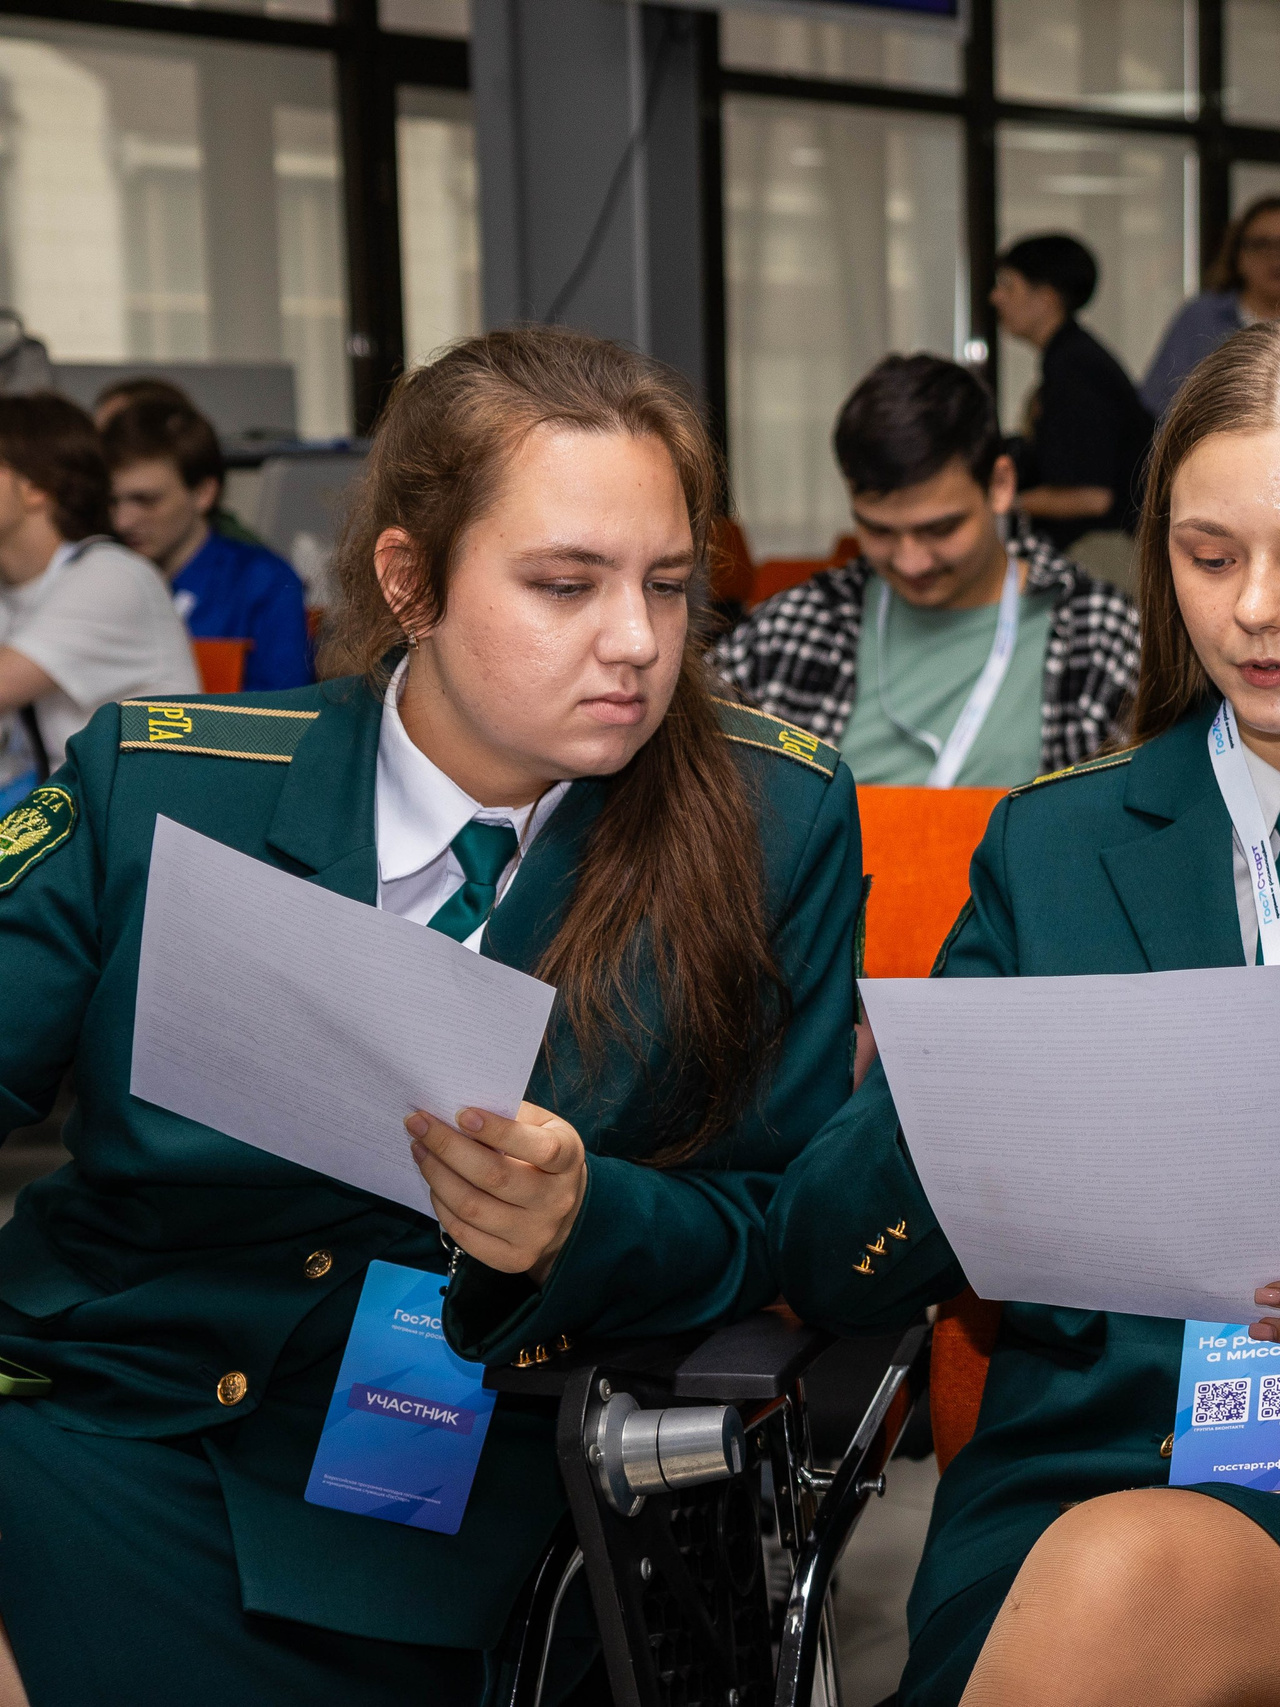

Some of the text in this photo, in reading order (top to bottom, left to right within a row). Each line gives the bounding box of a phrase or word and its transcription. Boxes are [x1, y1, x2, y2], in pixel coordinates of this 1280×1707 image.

[148, 706, 192, 742] РТА
[778, 730, 819, 761] РТА
[393, 1308, 442, 1330] ГосС
[1198, 1336, 1228, 1350] Не
[1206, 1352, 1221, 1363] а
[366, 1391, 459, 1427] УЧАСТНИК
